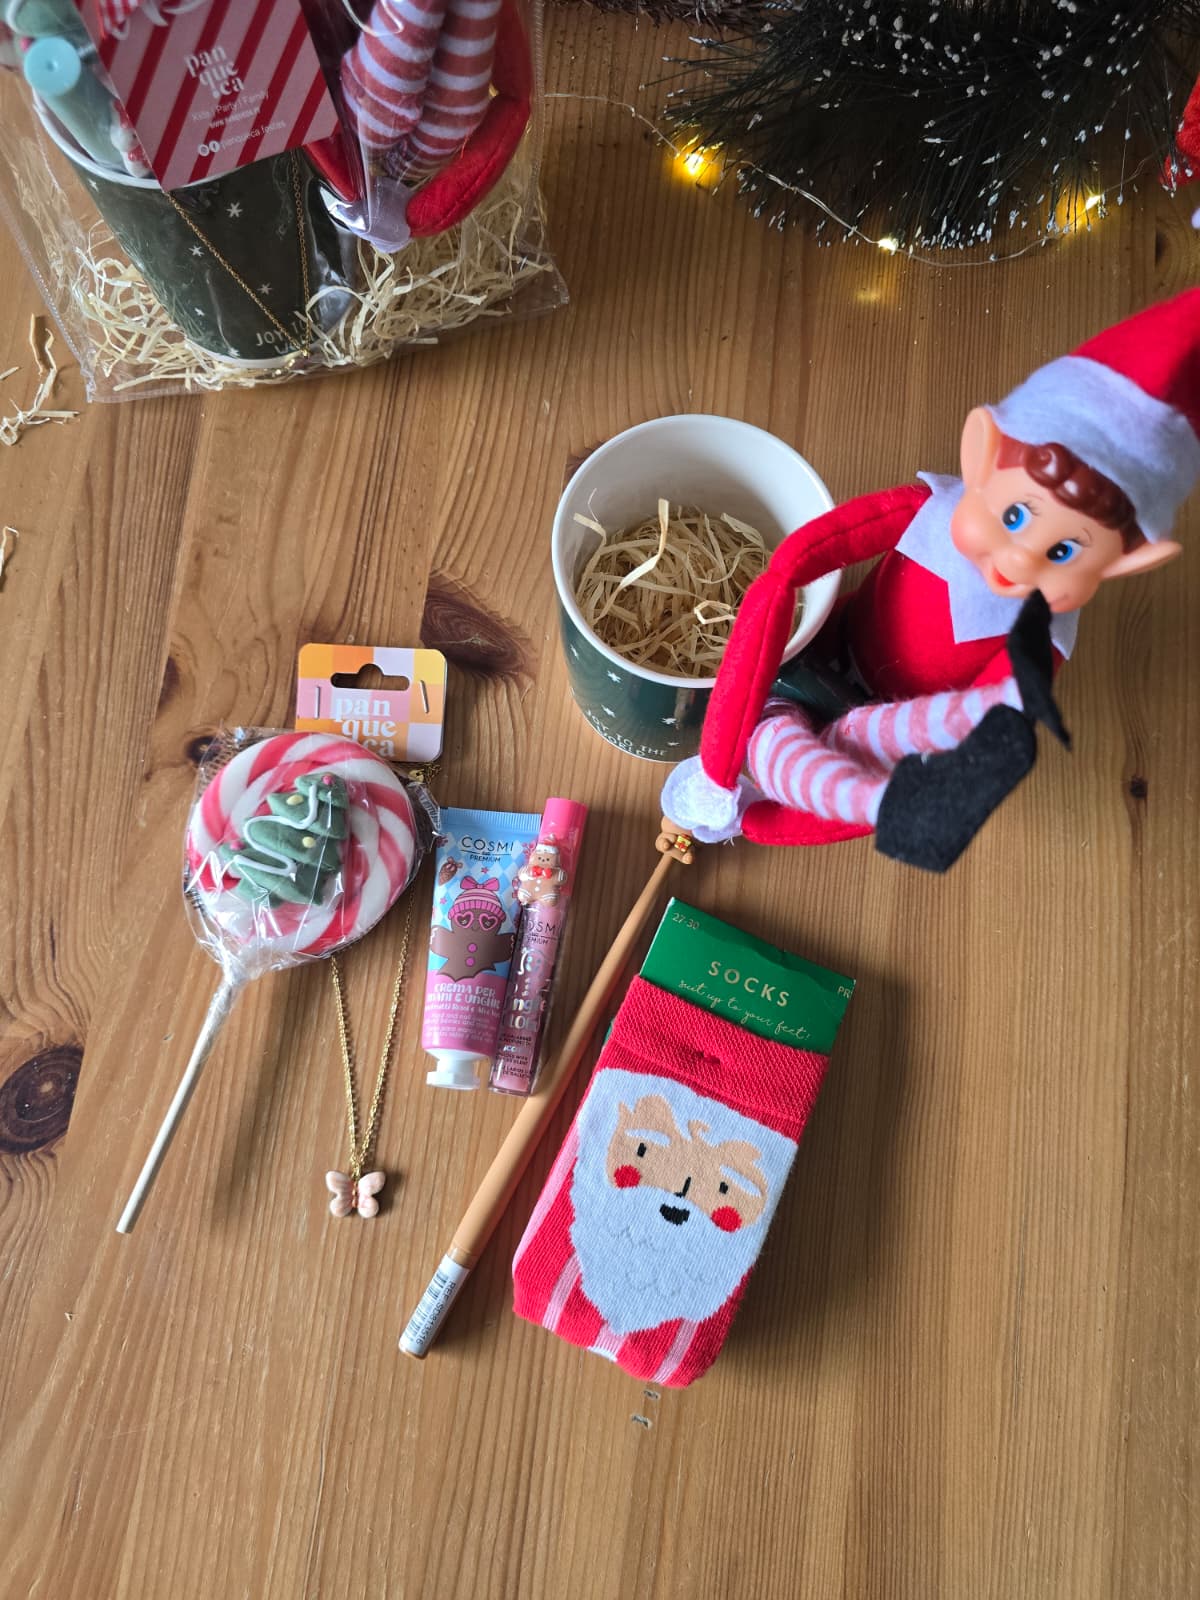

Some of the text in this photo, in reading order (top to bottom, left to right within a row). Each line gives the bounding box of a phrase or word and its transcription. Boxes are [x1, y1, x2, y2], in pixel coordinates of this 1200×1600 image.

[184, 45, 227, 78] pan
[199, 62, 239, 98] que
[219, 77, 245, 96] ca
[255, 328, 285, 347] JOY
[334, 697, 391, 722] pan
[341, 718, 398, 742] que
[615, 733, 634, 747] TO
[461, 836, 514, 852] COSMI
[434, 983, 497, 998] CREMA PER
[708, 960, 790, 1008] SOCKS
[727, 996, 743, 1012] to
[740, 1006, 774, 1025] your
